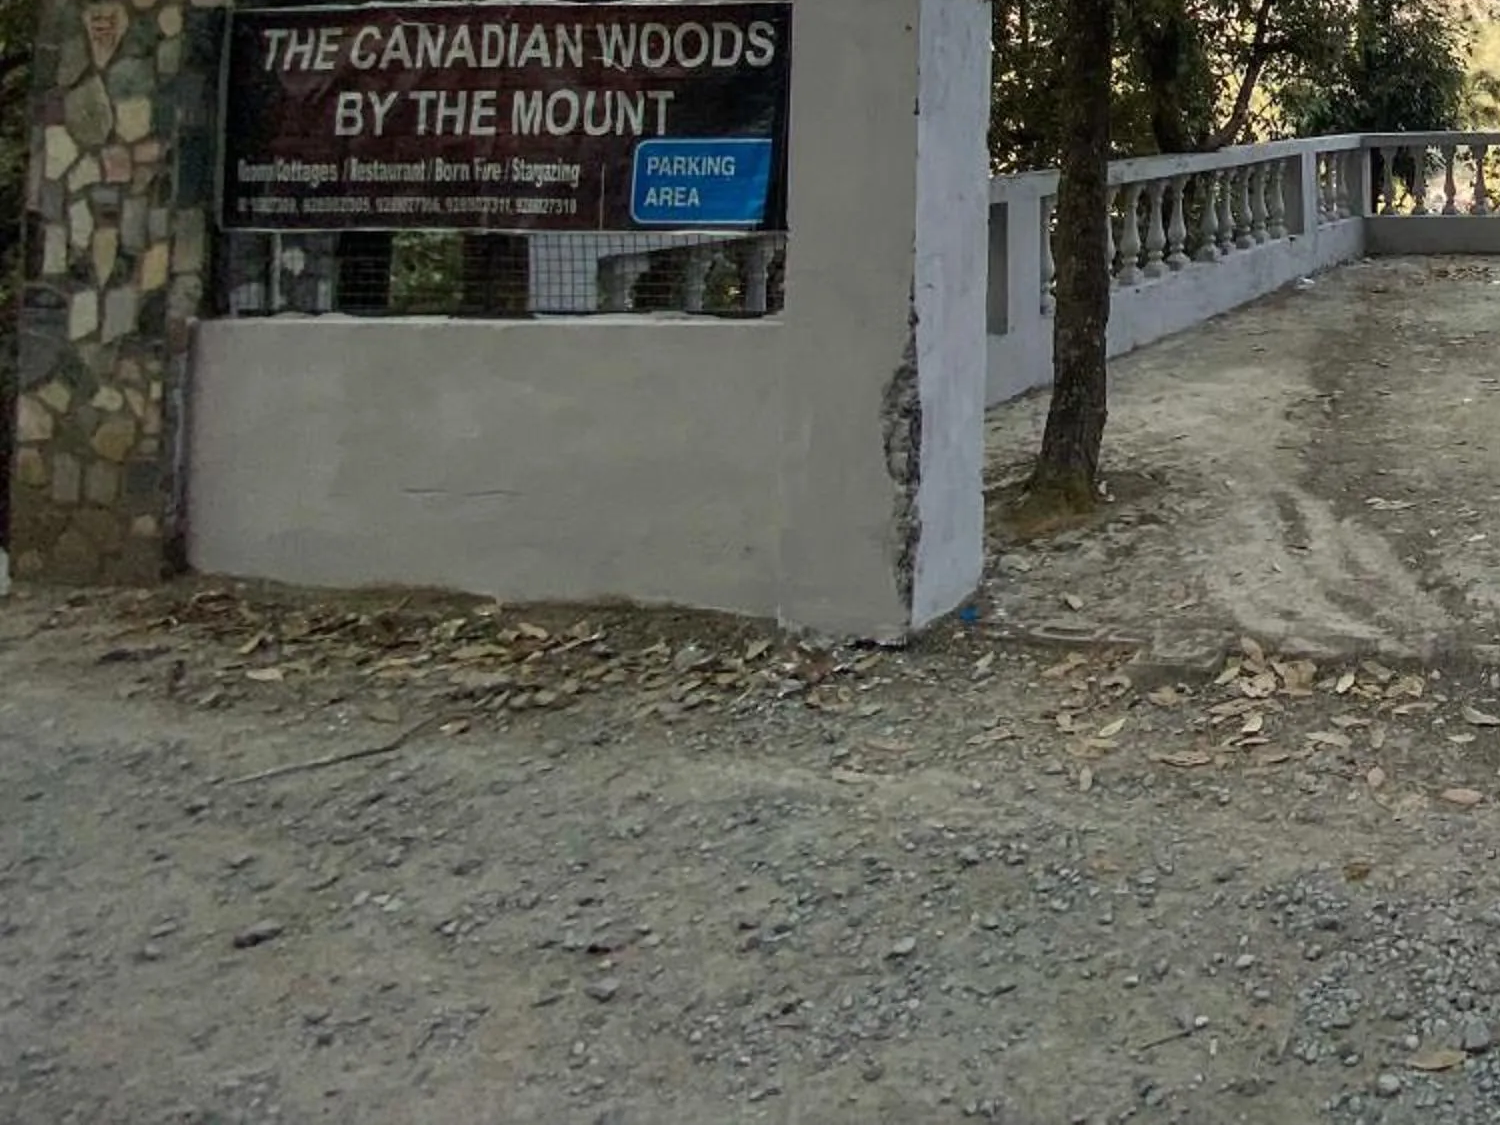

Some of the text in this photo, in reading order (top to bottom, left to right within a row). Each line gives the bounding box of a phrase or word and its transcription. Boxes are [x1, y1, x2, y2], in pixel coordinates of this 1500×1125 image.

[263, 21, 775, 71] THE CANADIAN WOODS
[334, 90, 675, 136] BY THE MOUNT
[435, 158, 469, 182] Born
[511, 156, 580, 188] Stargazing
[646, 156, 736, 176] PARKING
[644, 186, 700, 207] AREA
